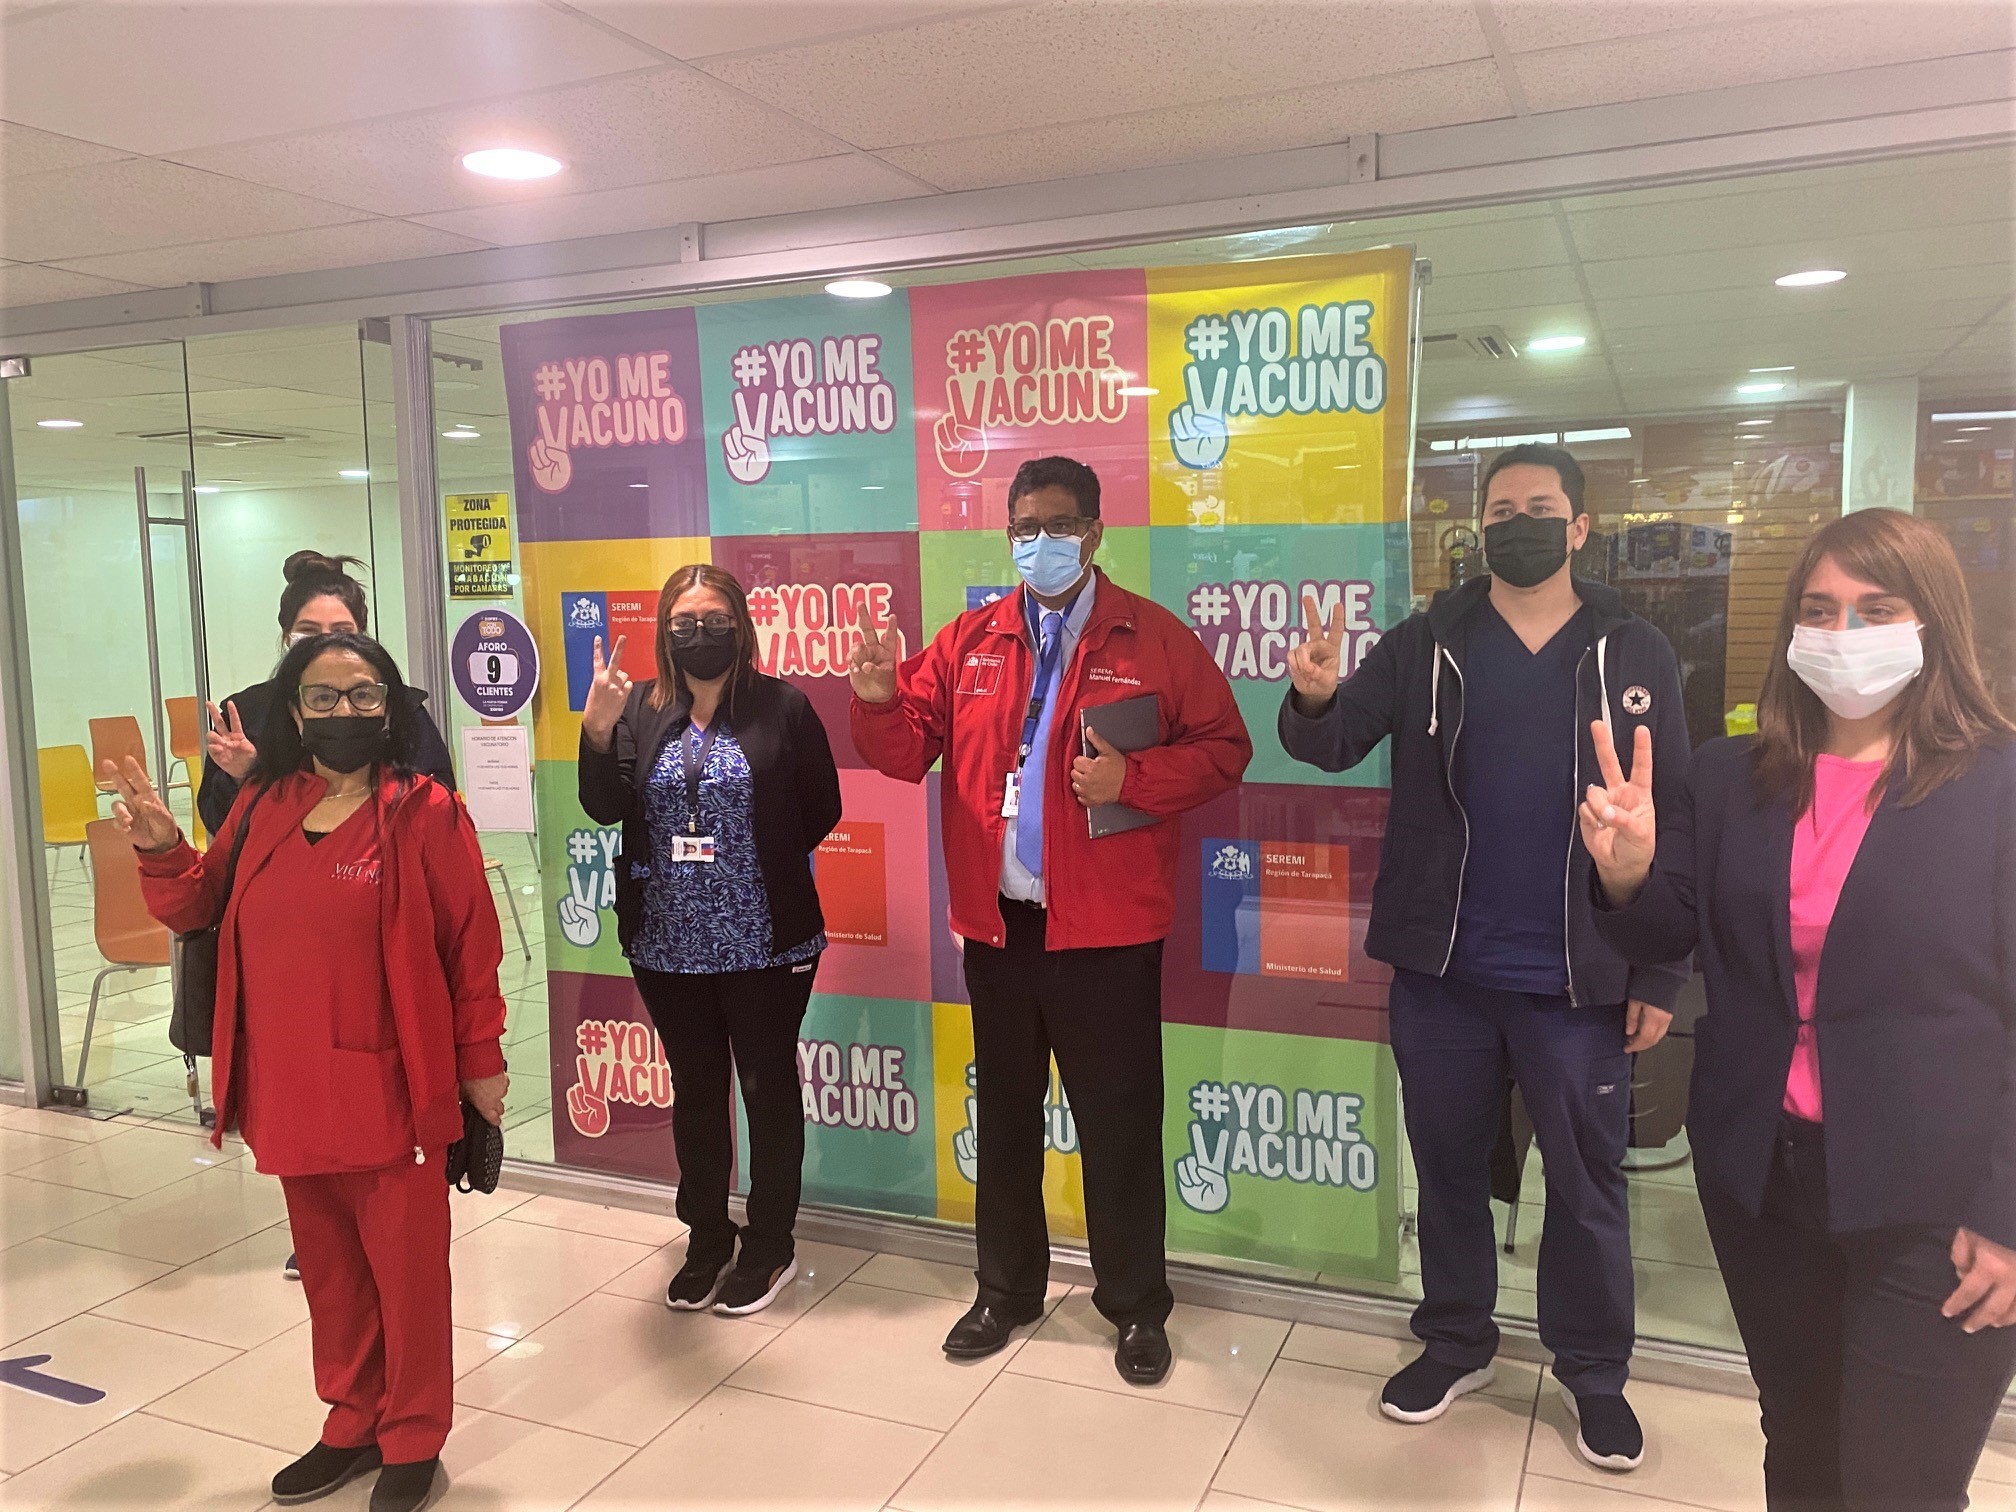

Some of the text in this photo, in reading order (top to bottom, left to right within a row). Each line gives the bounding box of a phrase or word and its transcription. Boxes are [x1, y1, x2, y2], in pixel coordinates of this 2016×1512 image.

[950, 319, 1112, 375] #YO ME
[1188, 303, 1370, 364] #YO ME
[536, 353, 672, 402] #YO ME
[733, 337, 880, 389] #YO ME
[948, 369, 1126, 432] VACUNO
[1186, 356, 1384, 421] VACUNO
[537, 397, 685, 458] VACUNO
[734, 384, 895, 447] VACUNO
[450, 517, 507, 531] PROTEGIDA
[463, 499, 491, 511] ZONA
[454, 584, 470, 593] POR
[611, 602, 642, 611] SEREMI
[747, 586, 889, 630] #YO ME
[1191, 583, 1371, 631] #YO ME
[477, 642, 508, 651] AFORO
[482, 626, 502, 634] TODO
[487, 655, 501, 684] 9
[476, 687, 514, 697] CLIENTES
[1265, 868, 1332, 880] Región de Tarapacá
[1266, 854, 1305, 865] SEREMI
[864, 933, 882, 941] Salud
[1265, 962, 1342, 976] Ministerio de Salud
[579, 1023, 648, 1065] #YO
[850, 1045, 903, 1090] ME
[801, 1081, 915, 1133] ACUNO
[1192, 1083, 1361, 1142] #YO ME
[1191, 1122, 1376, 1192] VACUNO
